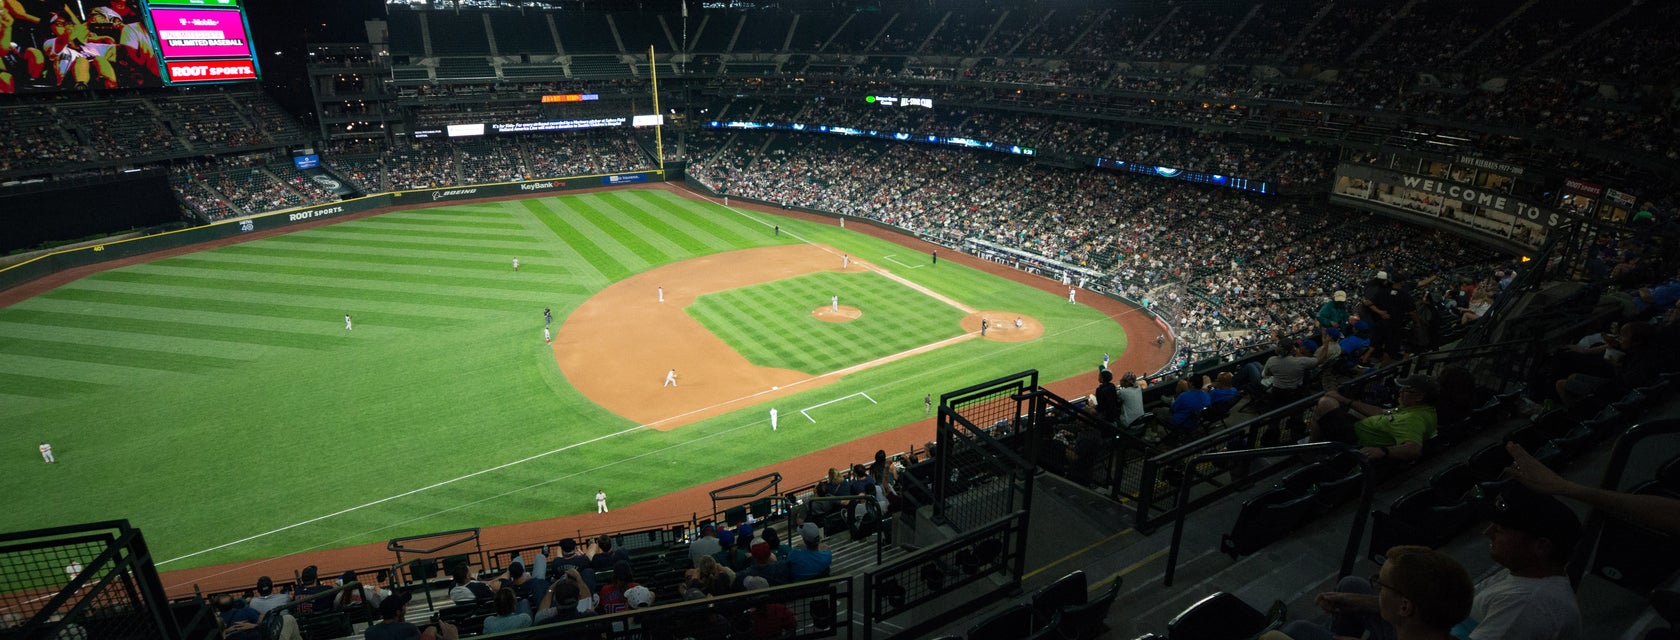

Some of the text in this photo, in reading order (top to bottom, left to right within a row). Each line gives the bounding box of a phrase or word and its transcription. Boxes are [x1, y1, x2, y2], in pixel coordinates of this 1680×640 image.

[172, 66, 251, 76] ROOT SPORTS
[520, 182, 554, 190] KeyBank
[1403, 176, 1540, 220] WELCOME TO
[289, 206, 342, 221] ROOT SPORTS
